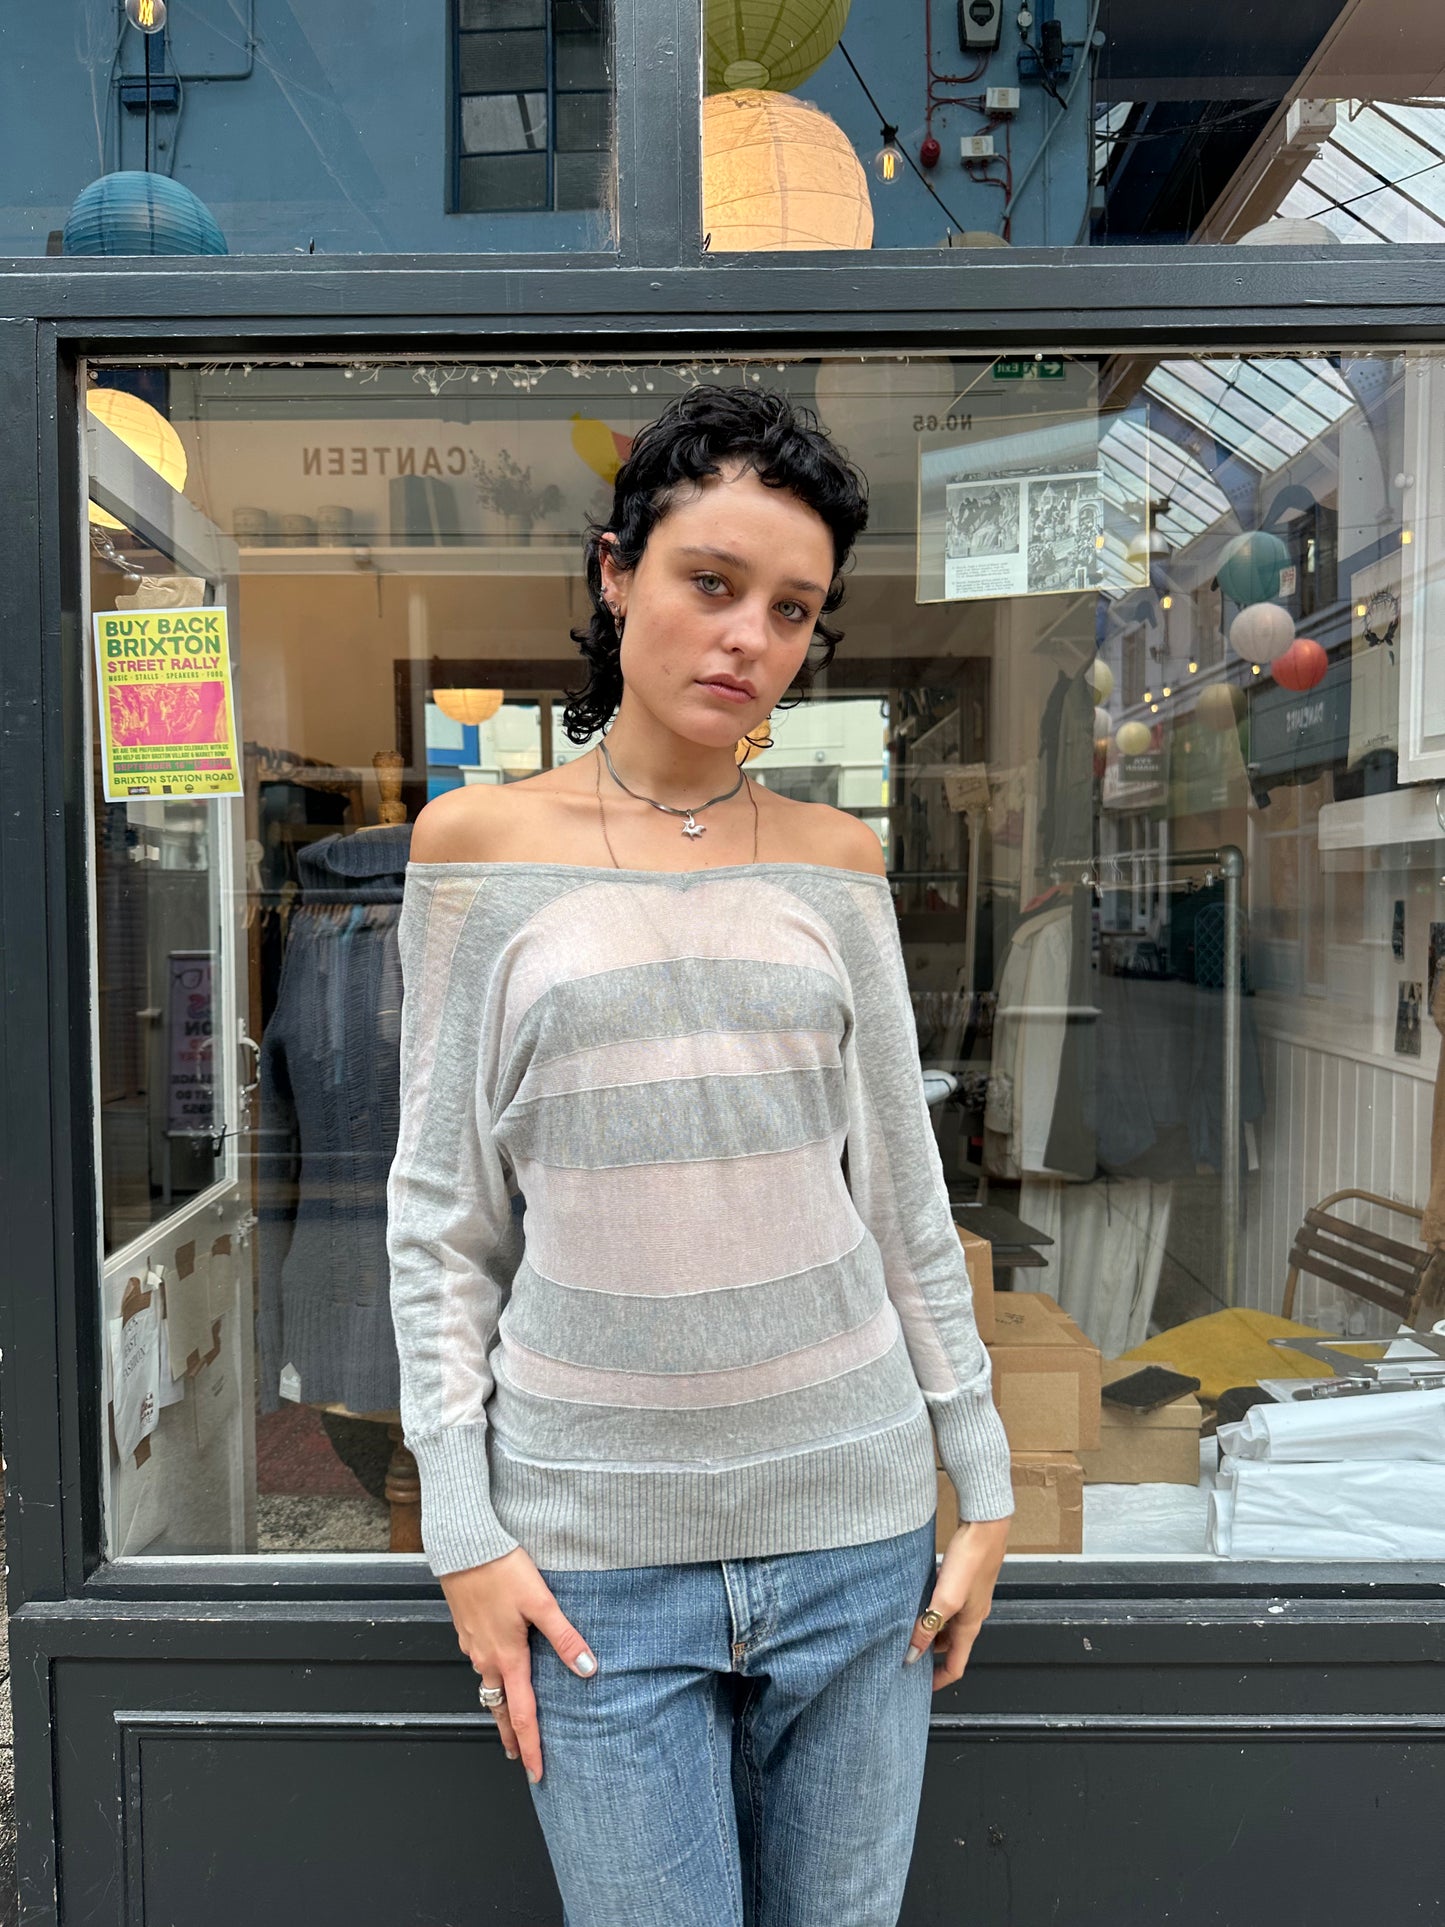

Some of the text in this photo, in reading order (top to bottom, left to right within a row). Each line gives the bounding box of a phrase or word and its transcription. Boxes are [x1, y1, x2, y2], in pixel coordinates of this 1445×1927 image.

[106, 617, 219, 637] BUY BACK
[107, 635, 221, 657] BRIXTON
[107, 656, 220, 673] STREET RALLY
[108, 670, 223, 682] MUSIC STALLS SPEAKERS FOOD
[115, 762, 171, 772] SEPTEMBER
[114, 773, 235, 785] BRIXTON STATION ROAD
